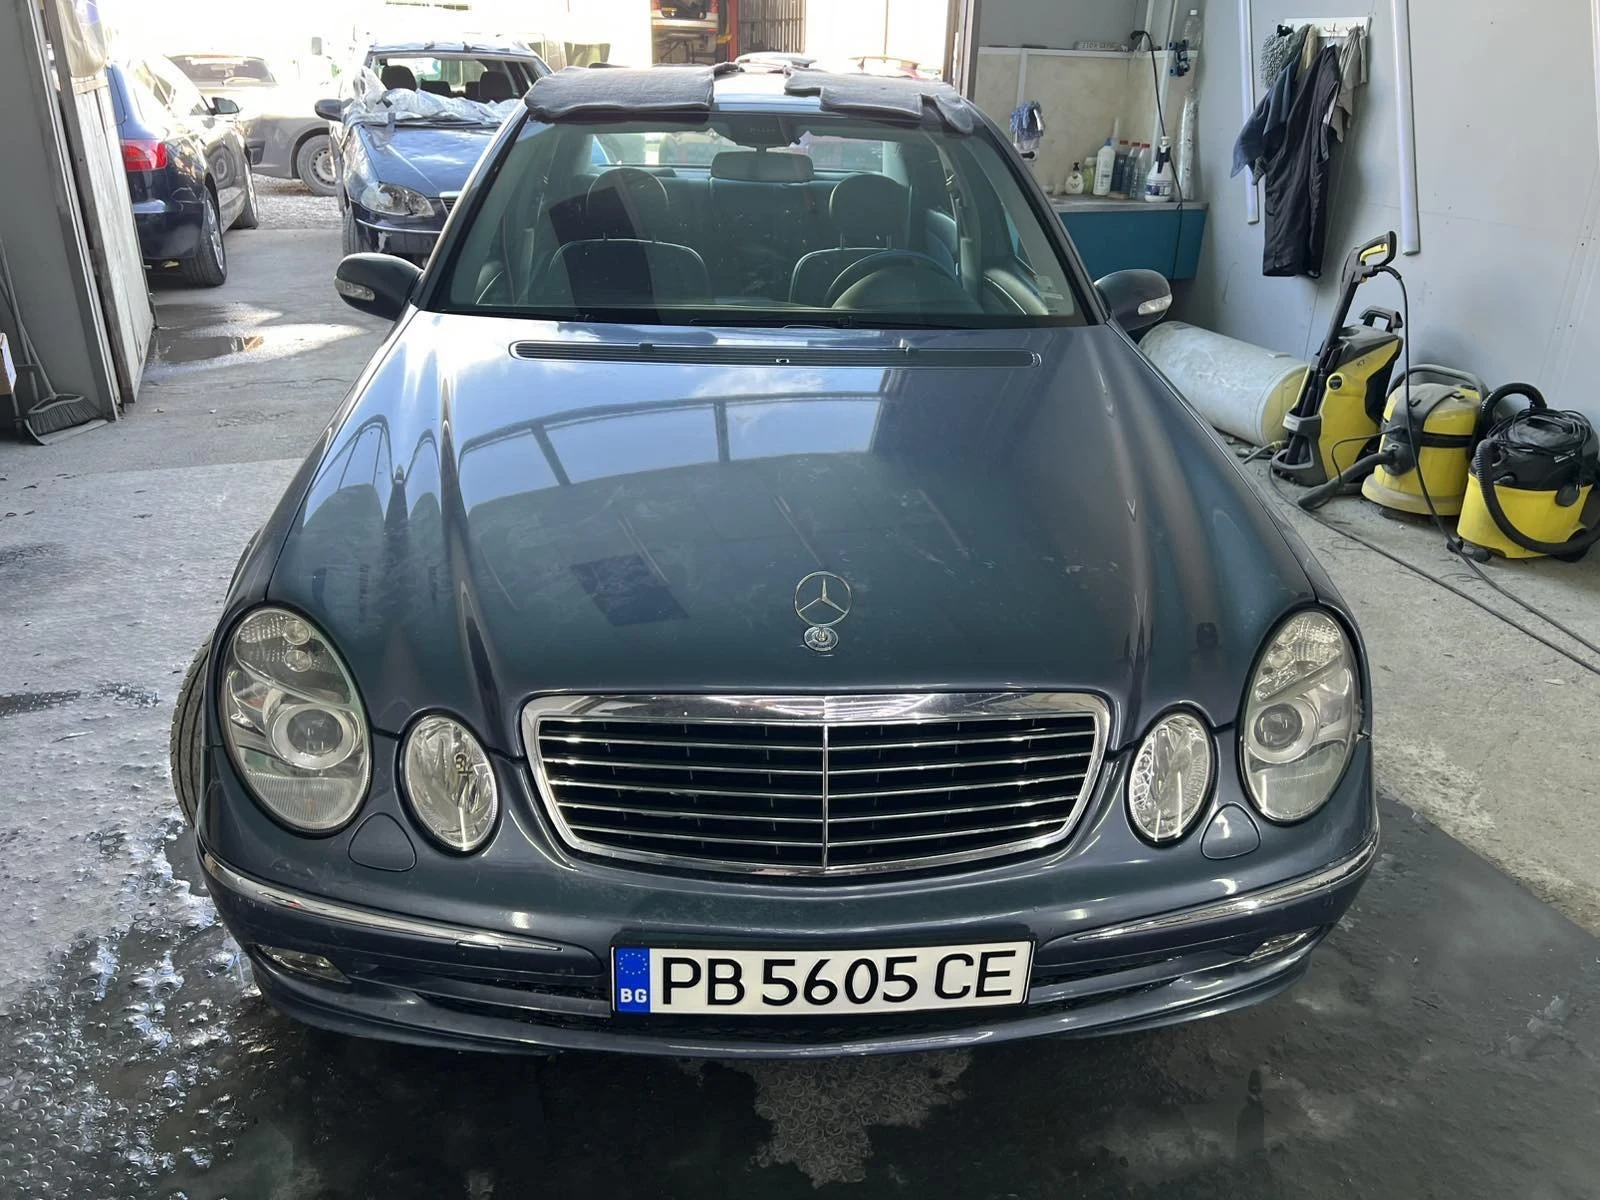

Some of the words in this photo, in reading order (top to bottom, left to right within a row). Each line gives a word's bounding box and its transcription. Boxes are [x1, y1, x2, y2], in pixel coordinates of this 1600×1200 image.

[620, 987, 648, 1003] BG
[662, 956, 746, 1005] PB
[762, 955, 918, 1007] 5605
[934, 949, 1017, 999] CE
